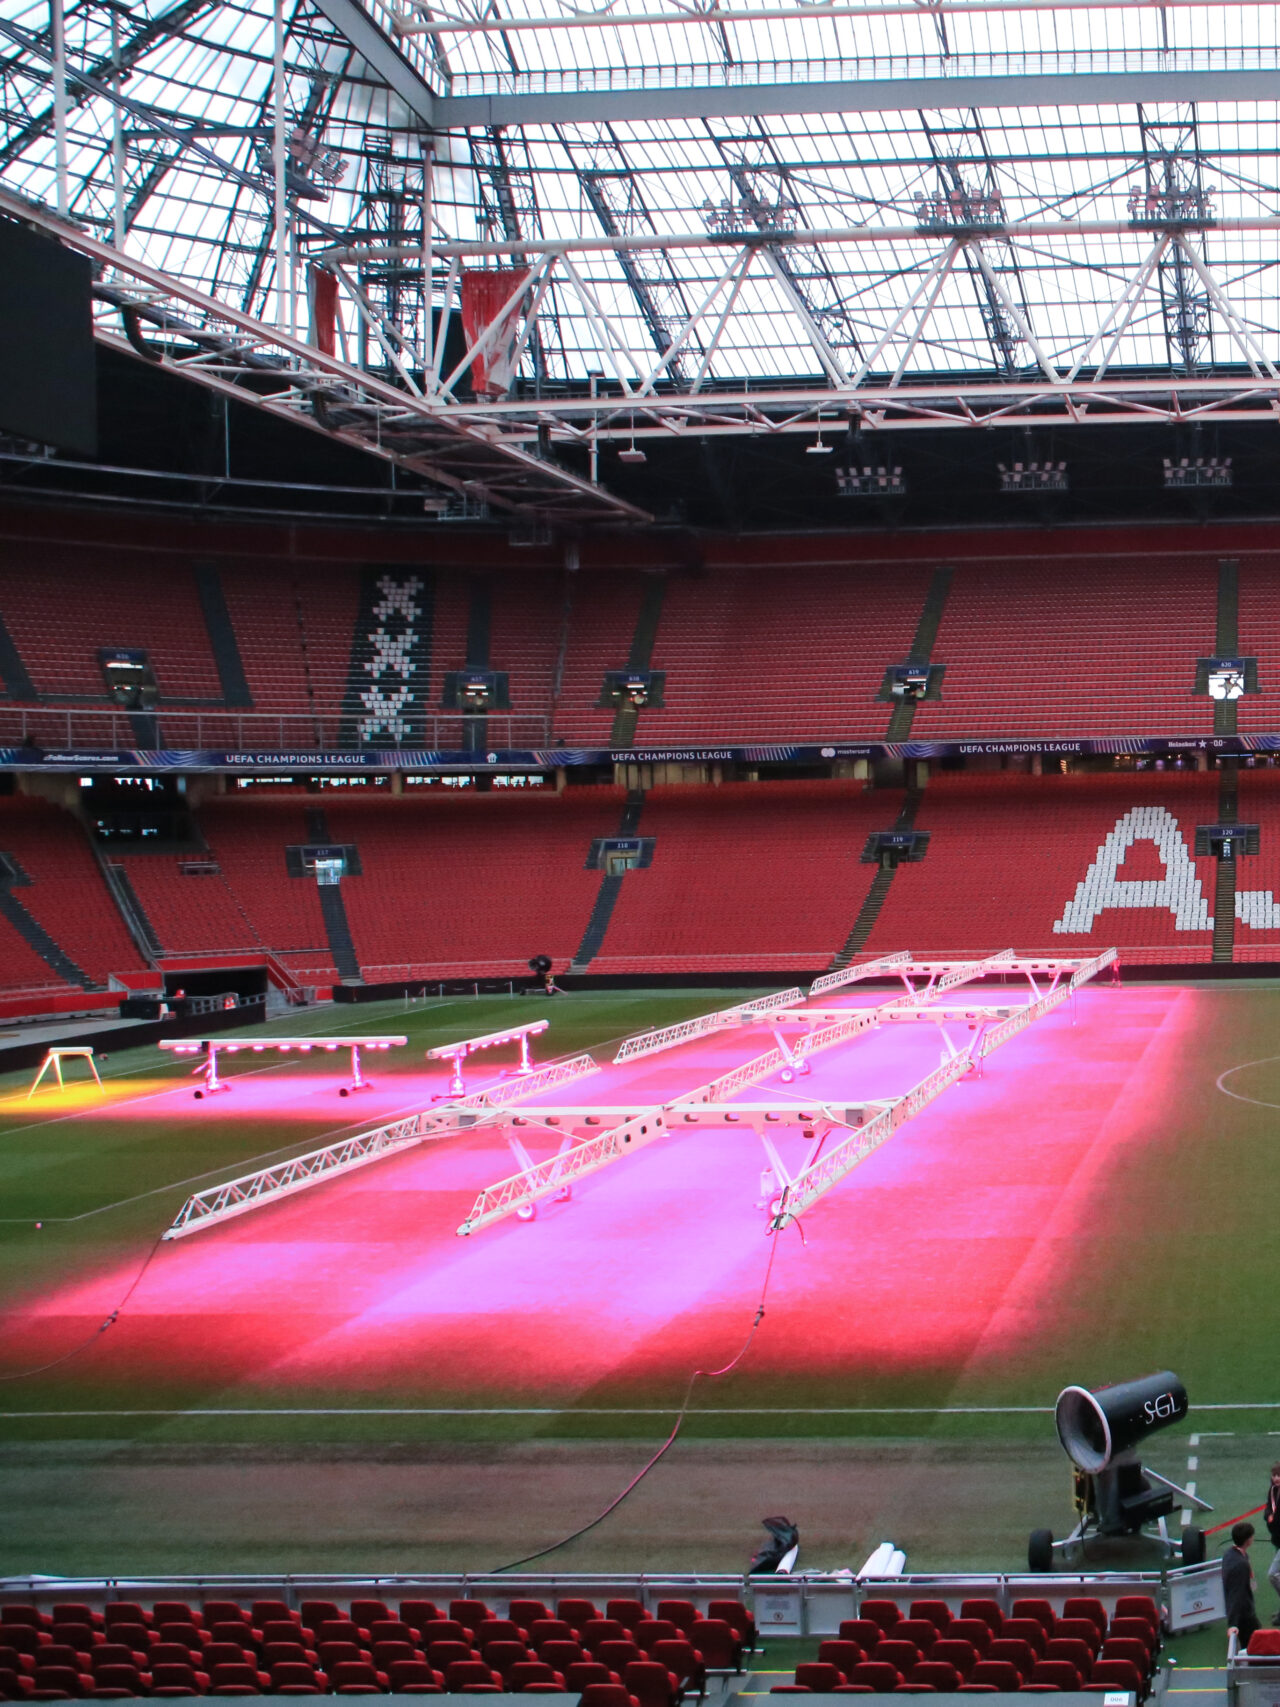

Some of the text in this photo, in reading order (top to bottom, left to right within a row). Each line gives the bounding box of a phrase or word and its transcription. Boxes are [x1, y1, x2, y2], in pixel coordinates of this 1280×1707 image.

[959, 742, 1081, 753] UEFA CHAMPIONS LEAGUE
[226, 754, 366, 764] UEFA CHAMPIONS LEAGUE
[611, 753, 635, 761] UEFA
[637, 752, 694, 760] CHAMPIONS
[1144, 1392, 1181, 1425] SGL
